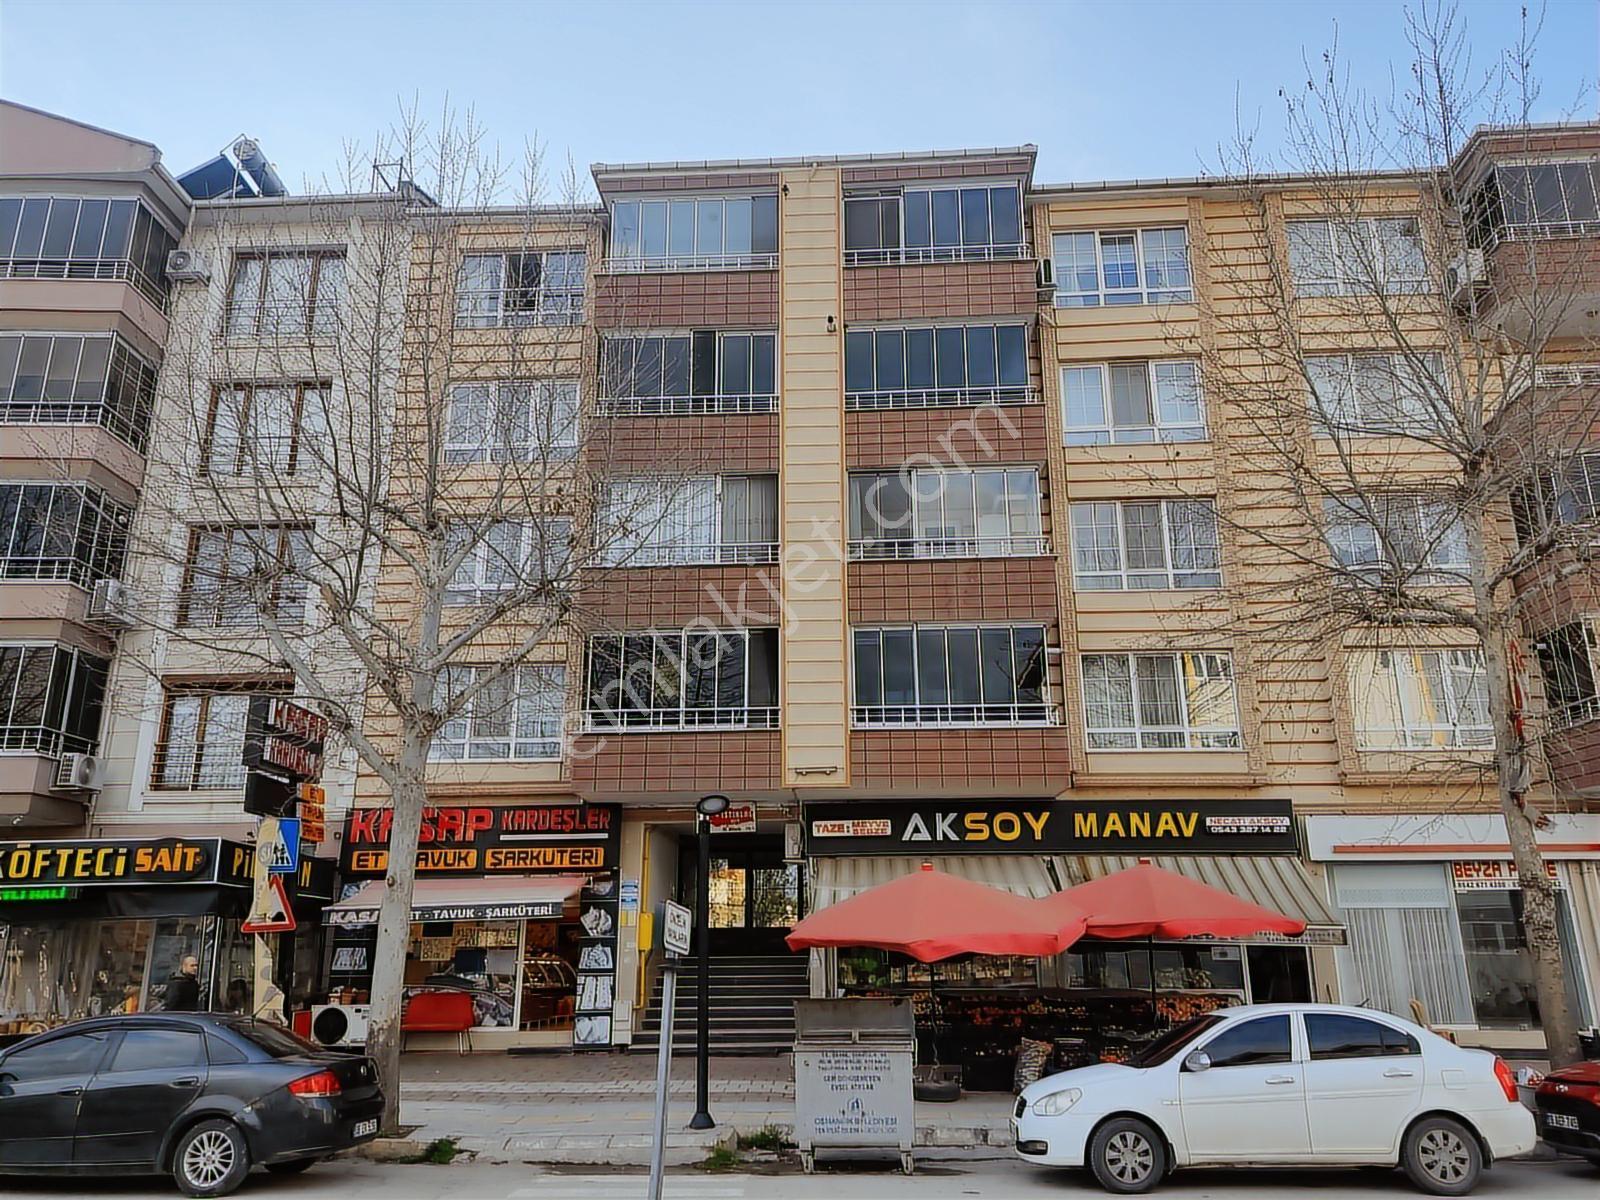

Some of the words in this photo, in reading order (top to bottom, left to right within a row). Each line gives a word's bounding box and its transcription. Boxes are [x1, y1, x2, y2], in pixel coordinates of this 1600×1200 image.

[502, 808, 610, 832] KARDEŞLER
[901, 811, 1050, 841] AKSOY
[1073, 811, 1199, 838] MANAV
[0, 843, 128, 879] ÖFTECİ
[134, 843, 199, 872] SAİT
[356, 853, 384, 869] ET
[415, 852, 472, 869] AVUK
[1454, 860, 1501, 878] BEYZA
[432, 909, 475, 919] TAVUK
[485, 903, 553, 920] ŞARKÜTERİ
